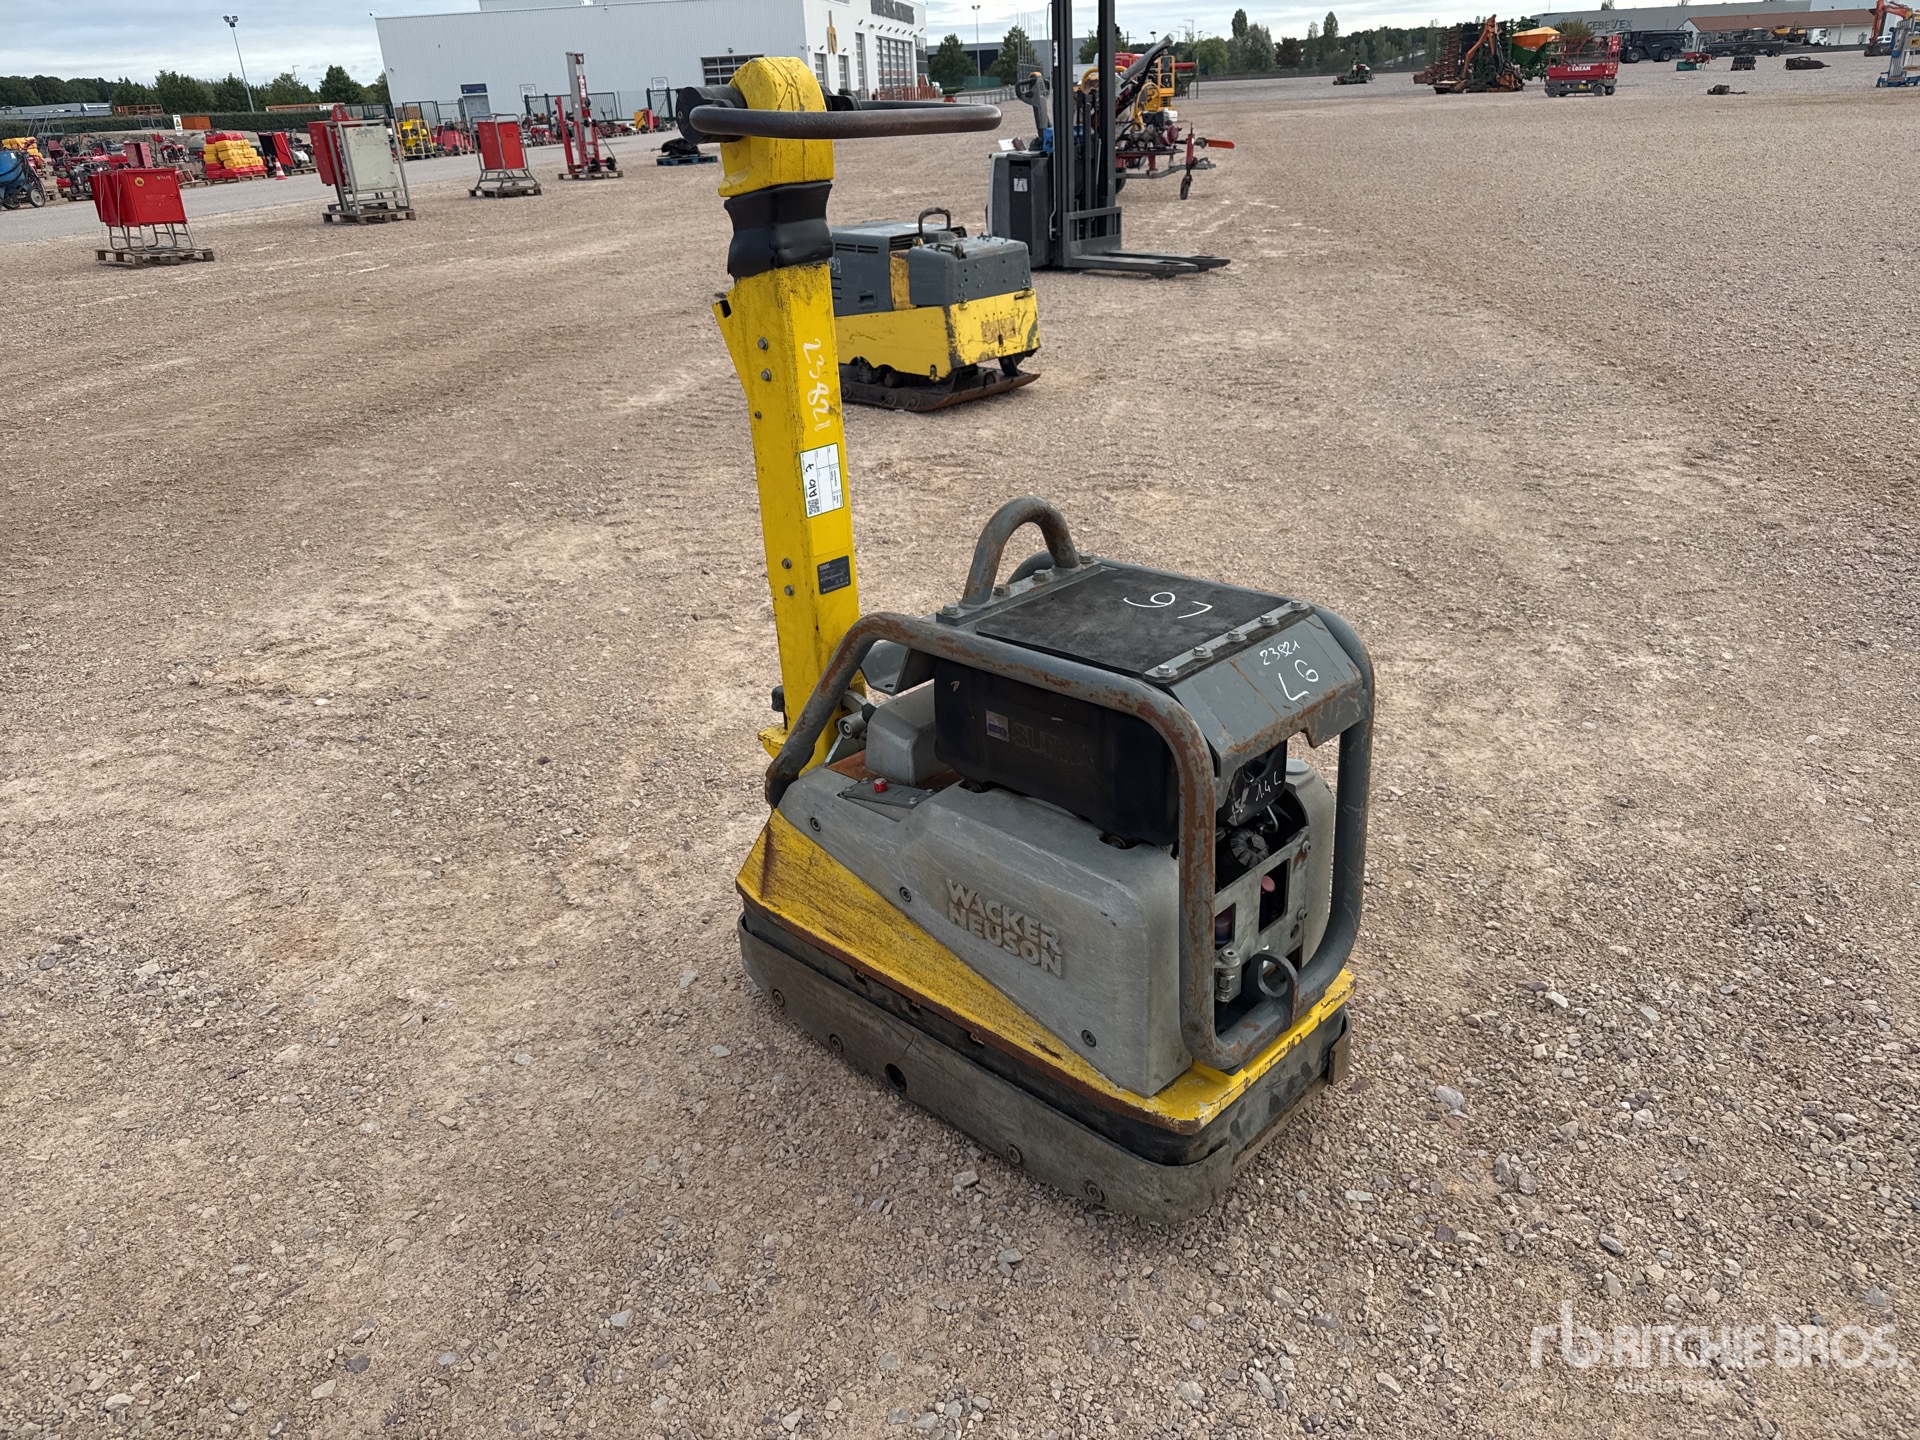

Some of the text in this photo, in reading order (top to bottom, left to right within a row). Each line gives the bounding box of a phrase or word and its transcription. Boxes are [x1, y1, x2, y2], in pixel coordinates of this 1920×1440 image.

[803, 338, 831, 432] 23821
[1260, 640, 1301, 666] 23821
[945, 877, 1062, 956] WACKER
[948, 899, 1063, 979] NEUSON
